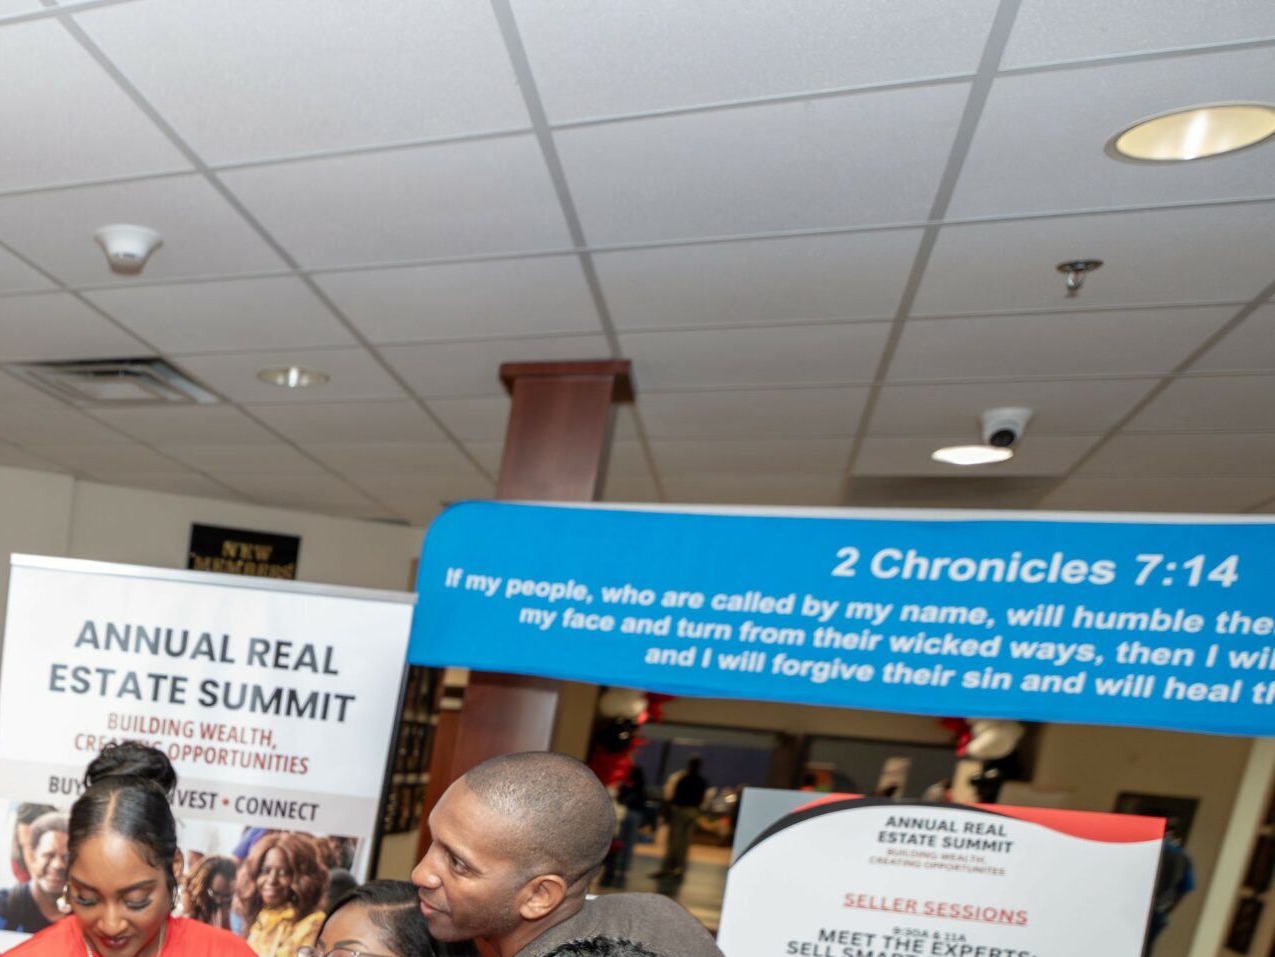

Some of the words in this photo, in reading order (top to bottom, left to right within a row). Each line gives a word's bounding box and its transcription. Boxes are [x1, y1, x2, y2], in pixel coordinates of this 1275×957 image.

[831, 546, 860, 578] 2
[870, 548, 1117, 585] Chronicles
[1134, 554, 1239, 587] 7:14
[445, 567, 463, 588] If
[465, 573, 501, 597] my
[505, 577, 594, 605] people,
[601, 583, 656, 606] who
[661, 590, 705, 609] are
[711, 591, 796, 615] called
[801, 594, 839, 623] by
[845, 600, 894, 626] my
[900, 604, 995, 629] name,
[1006, 603, 1065, 628] will
[1072, 605, 1205, 633] humble
[1215, 610, 1275, 636] the
[75, 620, 234, 664] ANNUAL
[246, 637, 339, 676] REAL
[519, 606, 557, 631] my
[562, 607, 615, 632] face
[620, 615, 672, 637] and
[676, 617, 732, 640] turn
[739, 620, 806, 647] from
[812, 626, 883, 651] their
[889, 632, 1003, 658] wicked
[1010, 640, 1104, 667] ways,
[1116, 641, 1195, 667] then
[1205, 644, 1219, 668] I
[48, 663, 189, 705] ESTATE
[197, 679, 356, 724] SUMMIT
[644, 646, 697, 667] and
[700, 647, 713, 669] I
[717, 650, 766, 673] will
[771, 652, 875, 684] forgive
[882, 663, 956, 687] their
[961, 666, 1012, 690] sin
[1020, 671, 1087, 694] and
[1094, 674, 1155, 698] will
[1163, 677, 1243, 704] heal
[108, 712, 195, 739] BUILDING
[200, 724, 278, 750] WEALTH,
[168, 743, 310, 775] OPPORTUNITIES
[48, 776, 82, 796] BUY
[235, 796, 320, 821] CONNECT
[878, 830, 936, 848] ESTATE
[942, 836, 1014, 853] SUMMIT
[885, 815, 958, 833] ANNUAL
[963, 821, 1007, 838] REAL
[869, 856, 922, 868] CREATING
[887, 849, 938, 860] BUILDING
[843, 892, 918, 914] SELLER
[923, 900, 1029, 926] SESSIONS
[818, 928, 876, 947] MEET
[882, 935, 925, 954] THE
